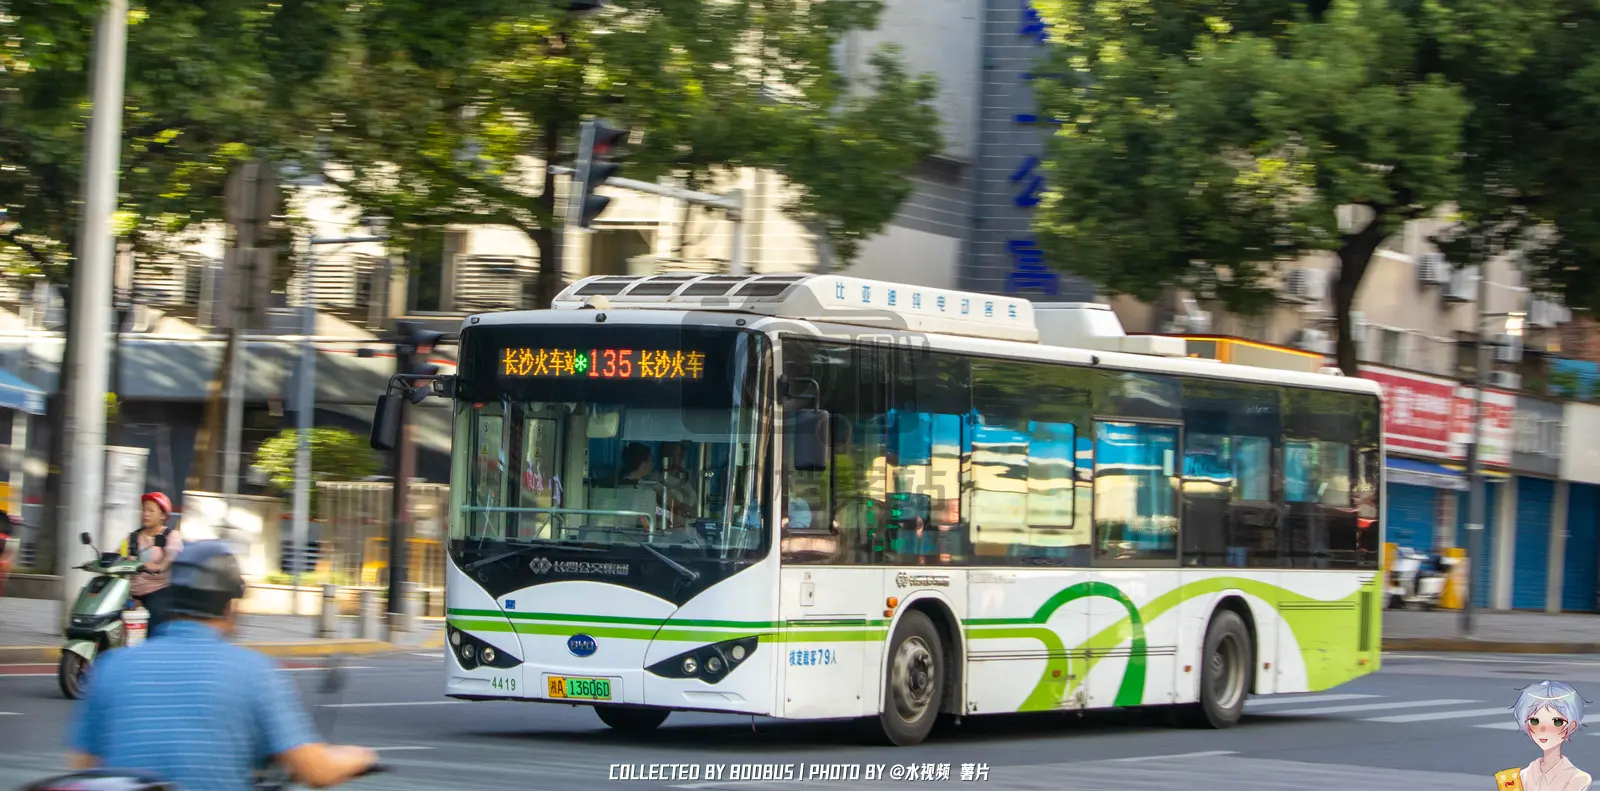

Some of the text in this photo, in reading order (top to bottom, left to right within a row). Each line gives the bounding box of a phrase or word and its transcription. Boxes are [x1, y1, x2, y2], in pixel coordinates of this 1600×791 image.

[502, 347, 706, 379] 长沙火车站 135 长沙火车
[570, 639, 595, 651] BYD
[491, 676, 516, 691] 4419
